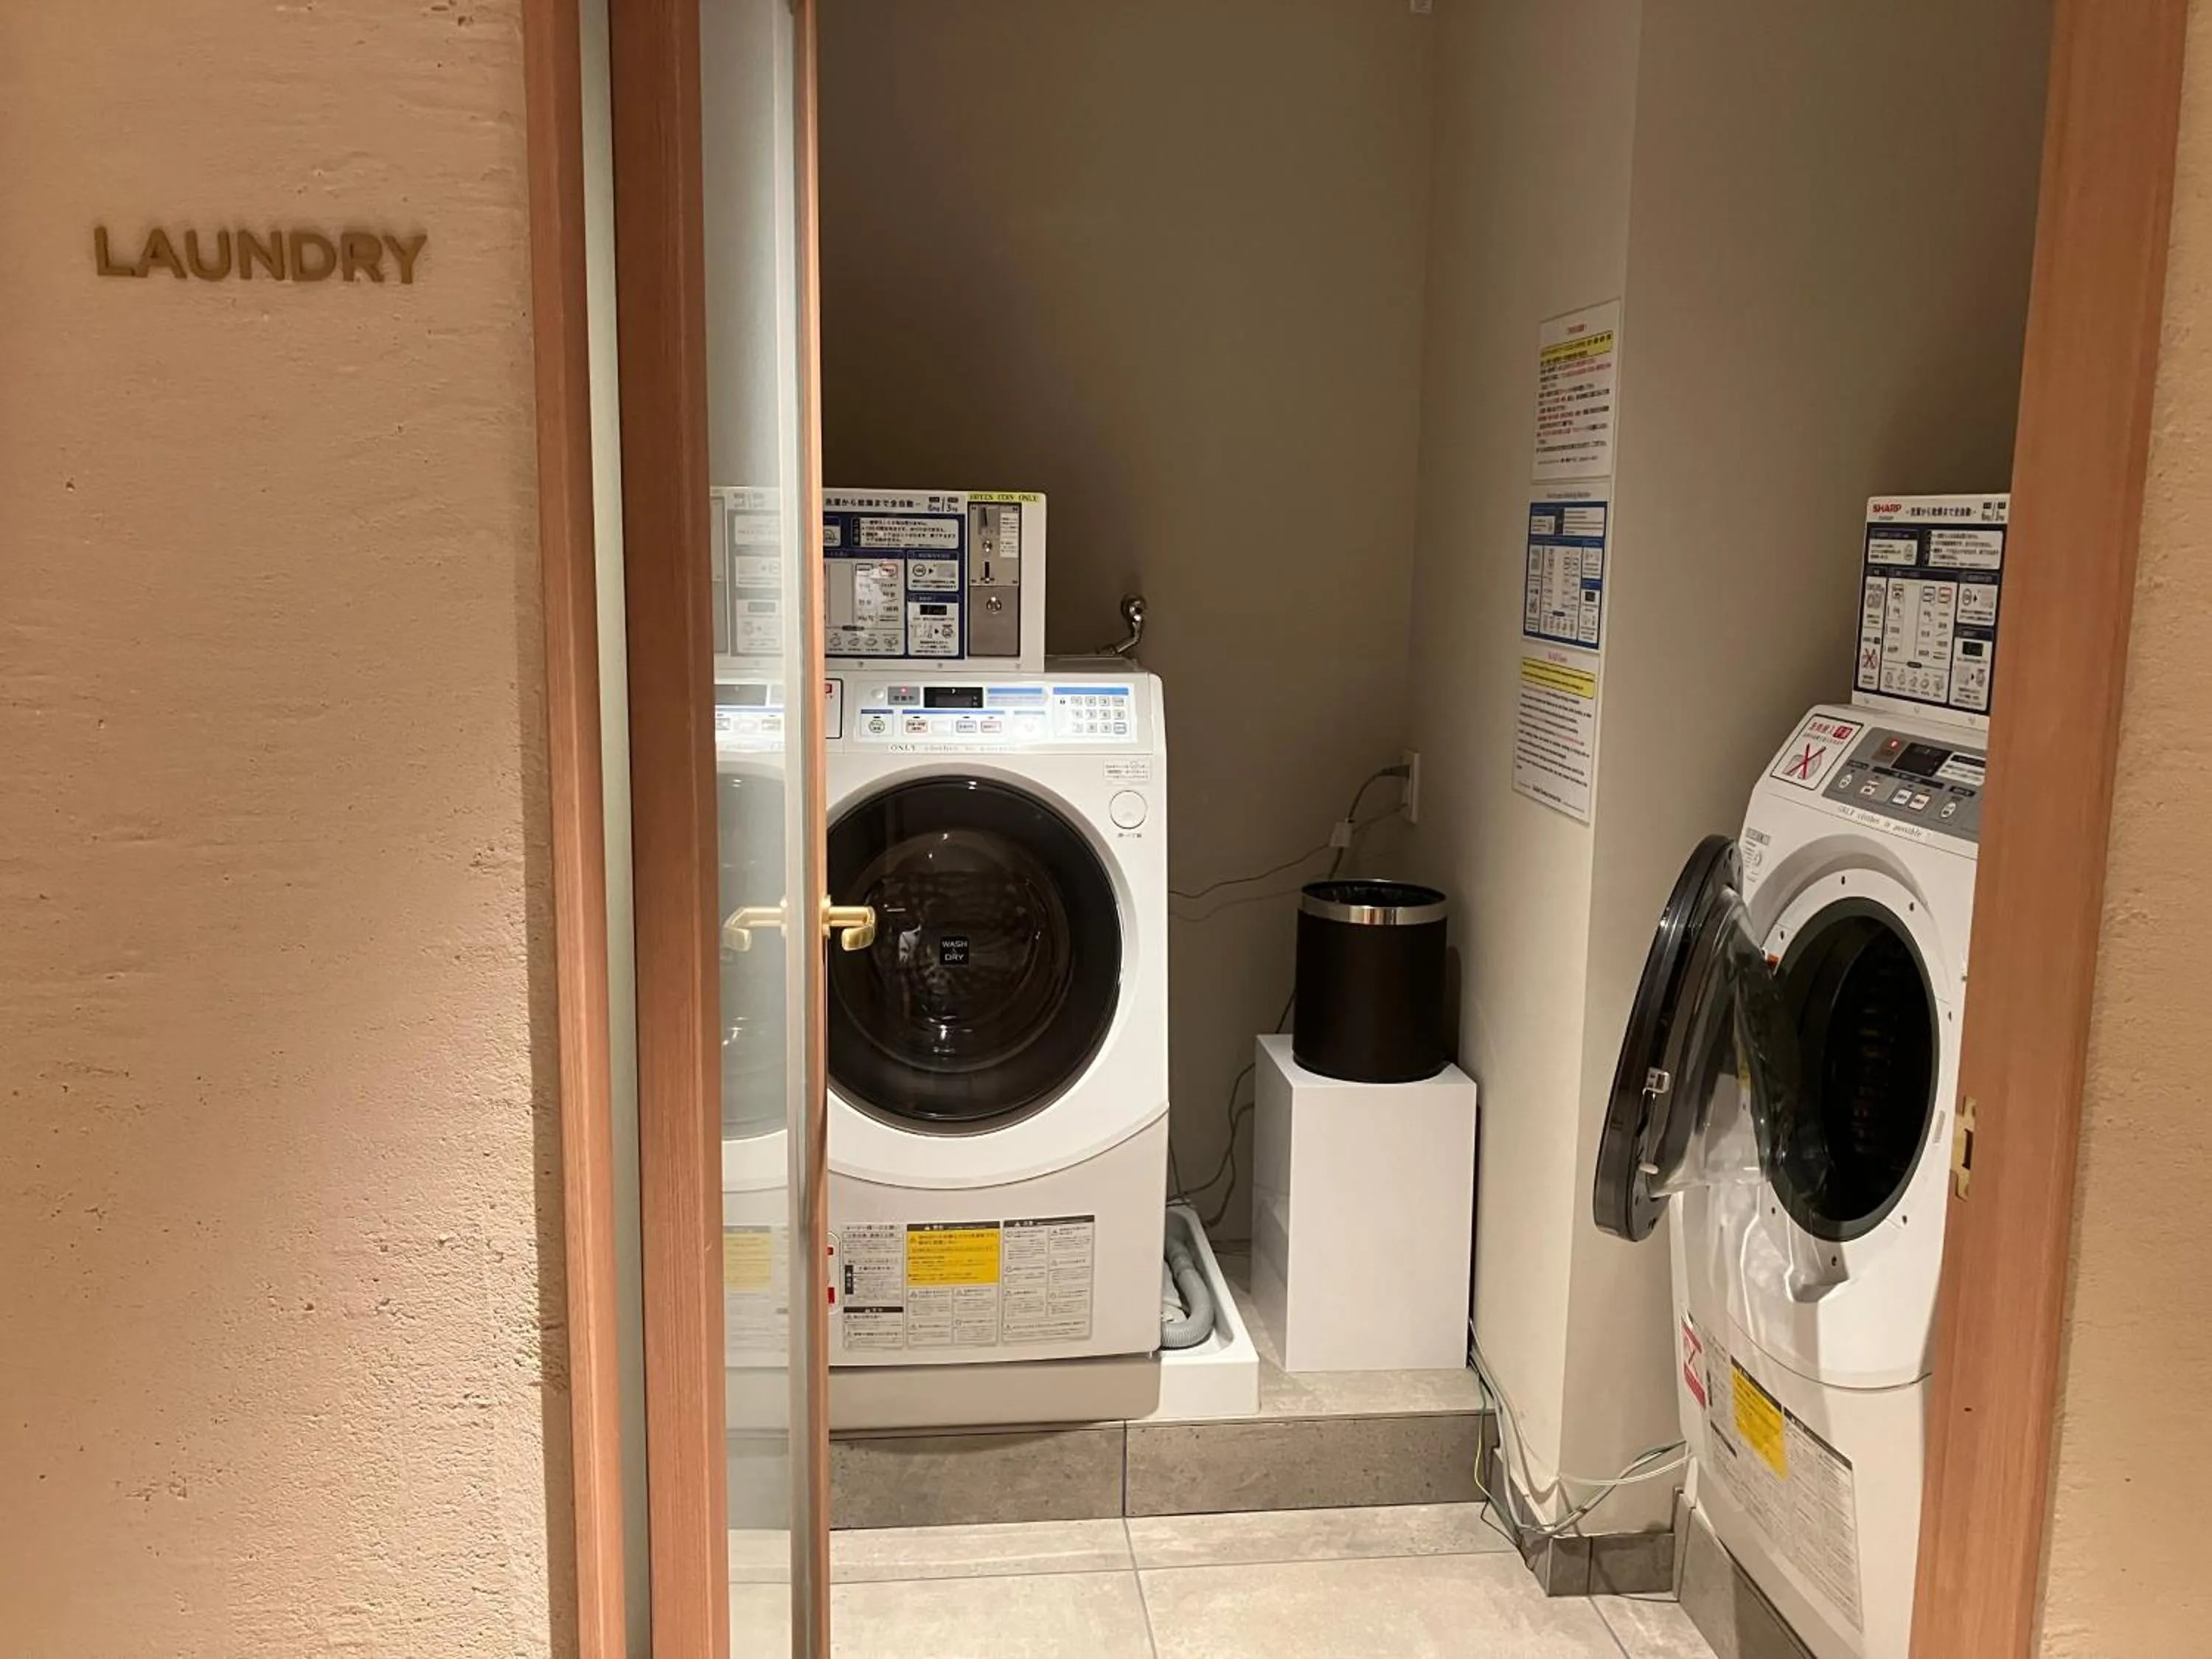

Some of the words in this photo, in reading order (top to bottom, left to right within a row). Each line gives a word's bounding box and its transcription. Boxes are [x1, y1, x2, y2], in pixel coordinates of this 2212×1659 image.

[94, 226, 428, 284] LAUNDRY
[1872, 504, 1902, 513] SHARP
[942, 940, 968, 948] WASH
[945, 953, 965, 961] DRY
